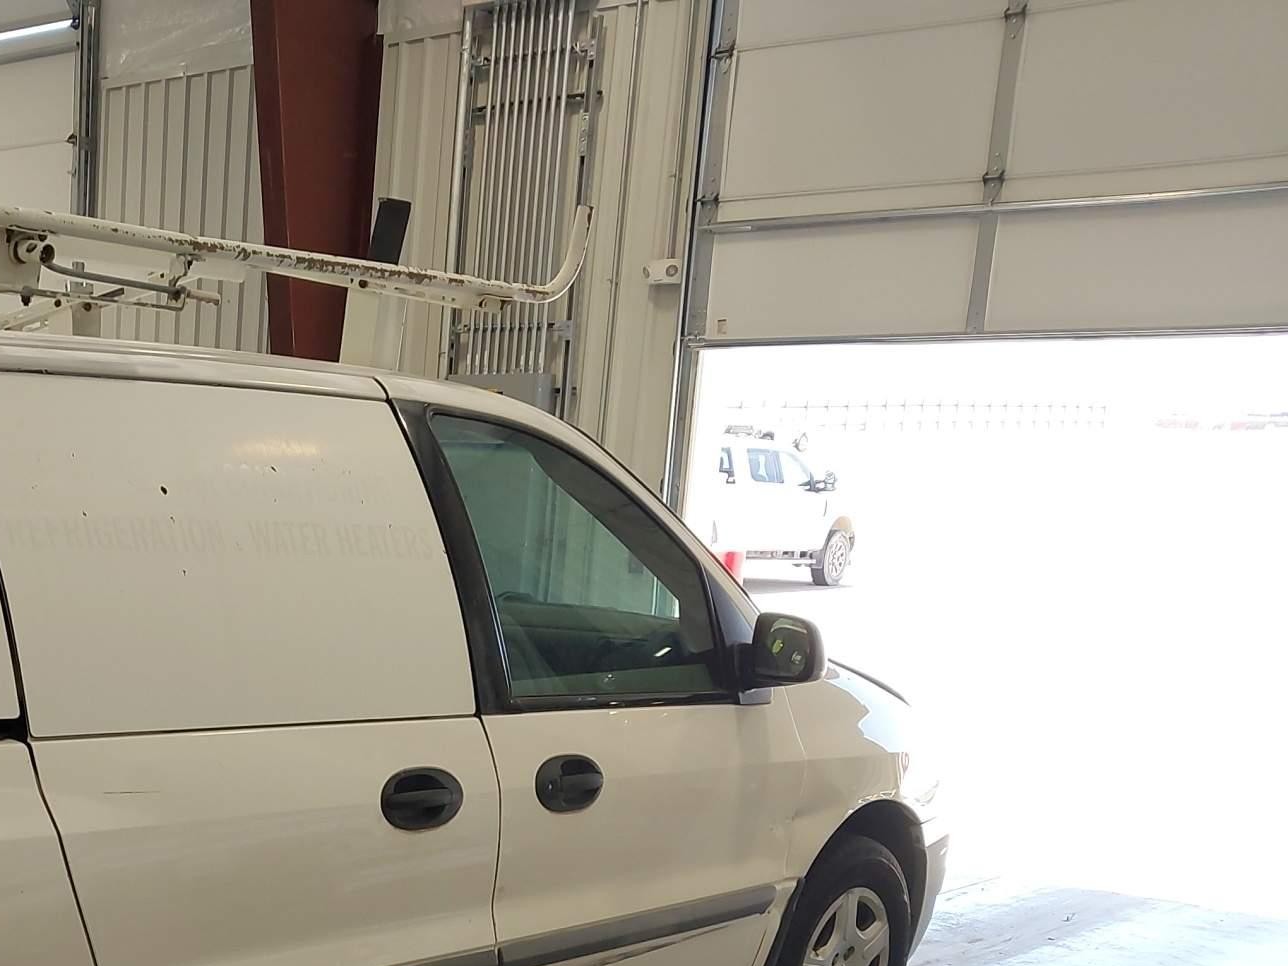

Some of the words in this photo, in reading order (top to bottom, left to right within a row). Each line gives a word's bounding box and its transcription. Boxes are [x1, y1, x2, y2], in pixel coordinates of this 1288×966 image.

[7, 516, 226, 555] REFRIGERATION
[246, 518, 332, 560] WATER
[334, 522, 433, 561] HEATERS
